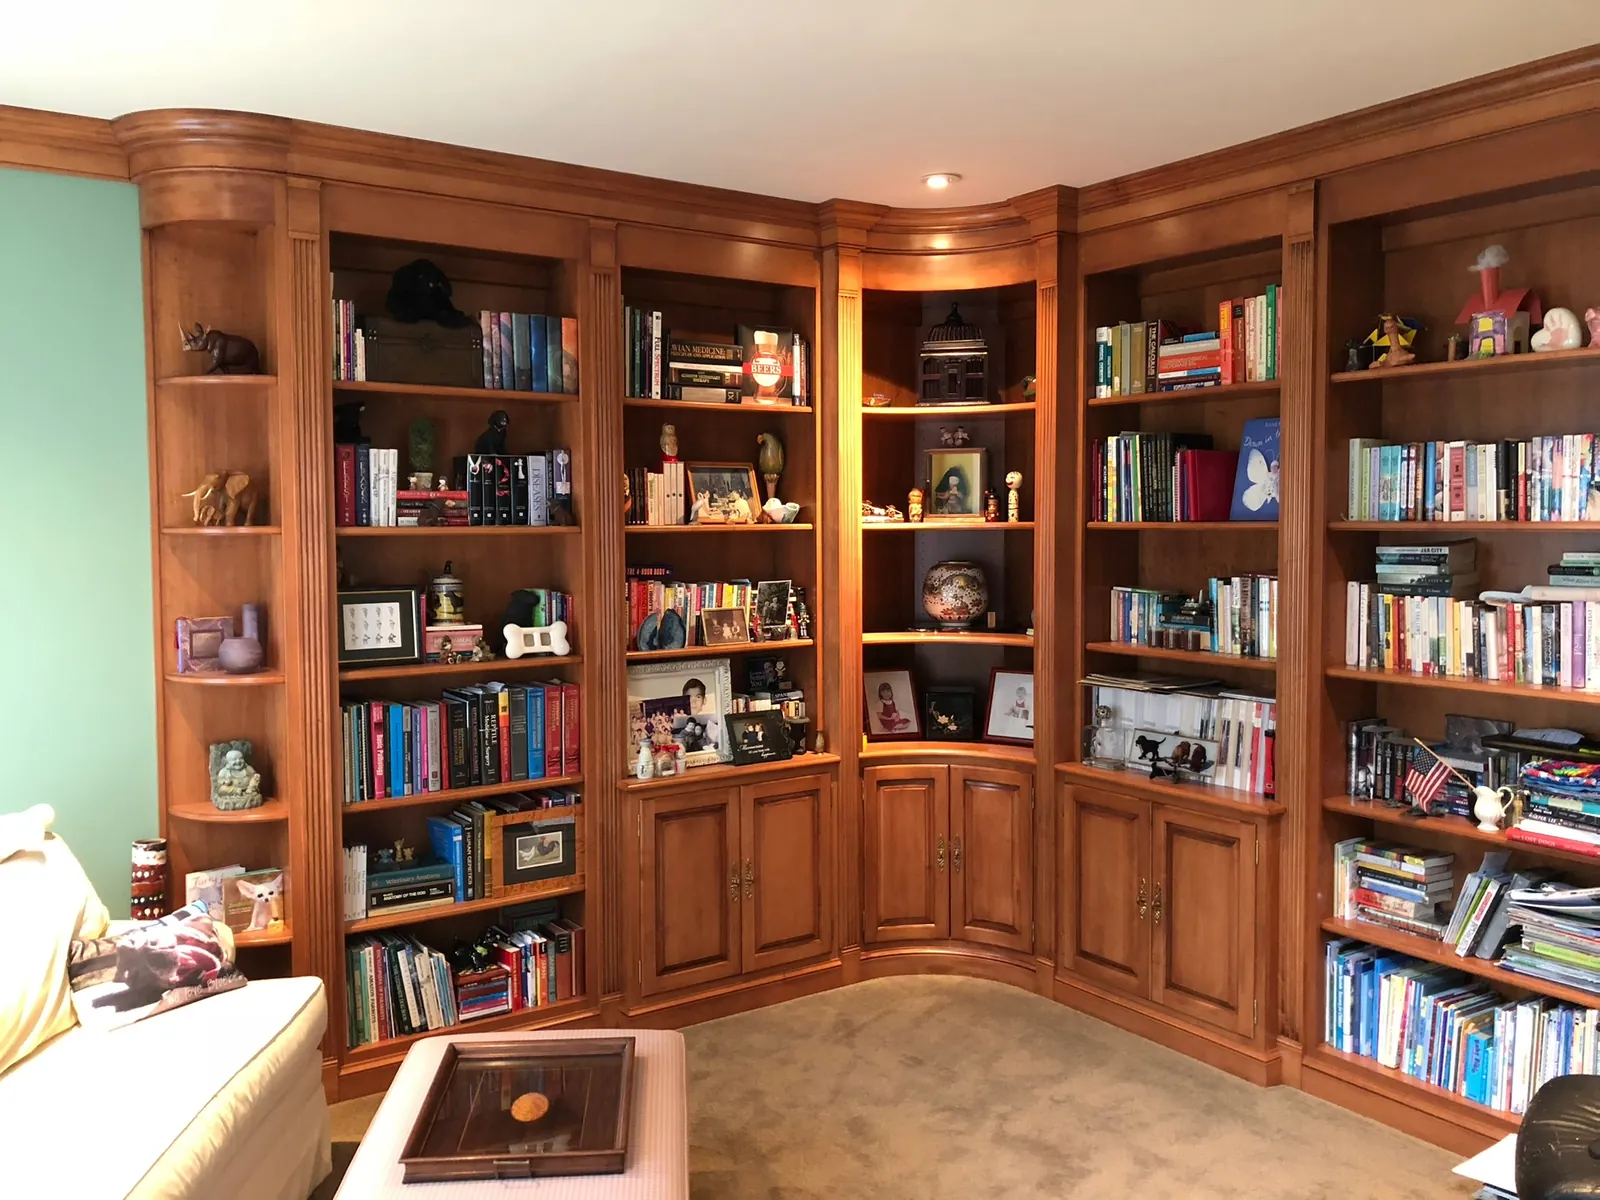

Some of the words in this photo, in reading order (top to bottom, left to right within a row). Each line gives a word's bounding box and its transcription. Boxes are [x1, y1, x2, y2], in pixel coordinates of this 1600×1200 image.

[752, 364, 782, 375] BEERS
[1244, 436, 1262, 447] Down
[1264, 436, 1272, 444] in
[532, 468, 542, 511] DISEASES
[376, 734, 384, 748] Basic
[376, 750, 384, 776] Pathology
[386, 875, 414, 886] Veterinary
[1474, 1040, 1482, 1056] Baby
